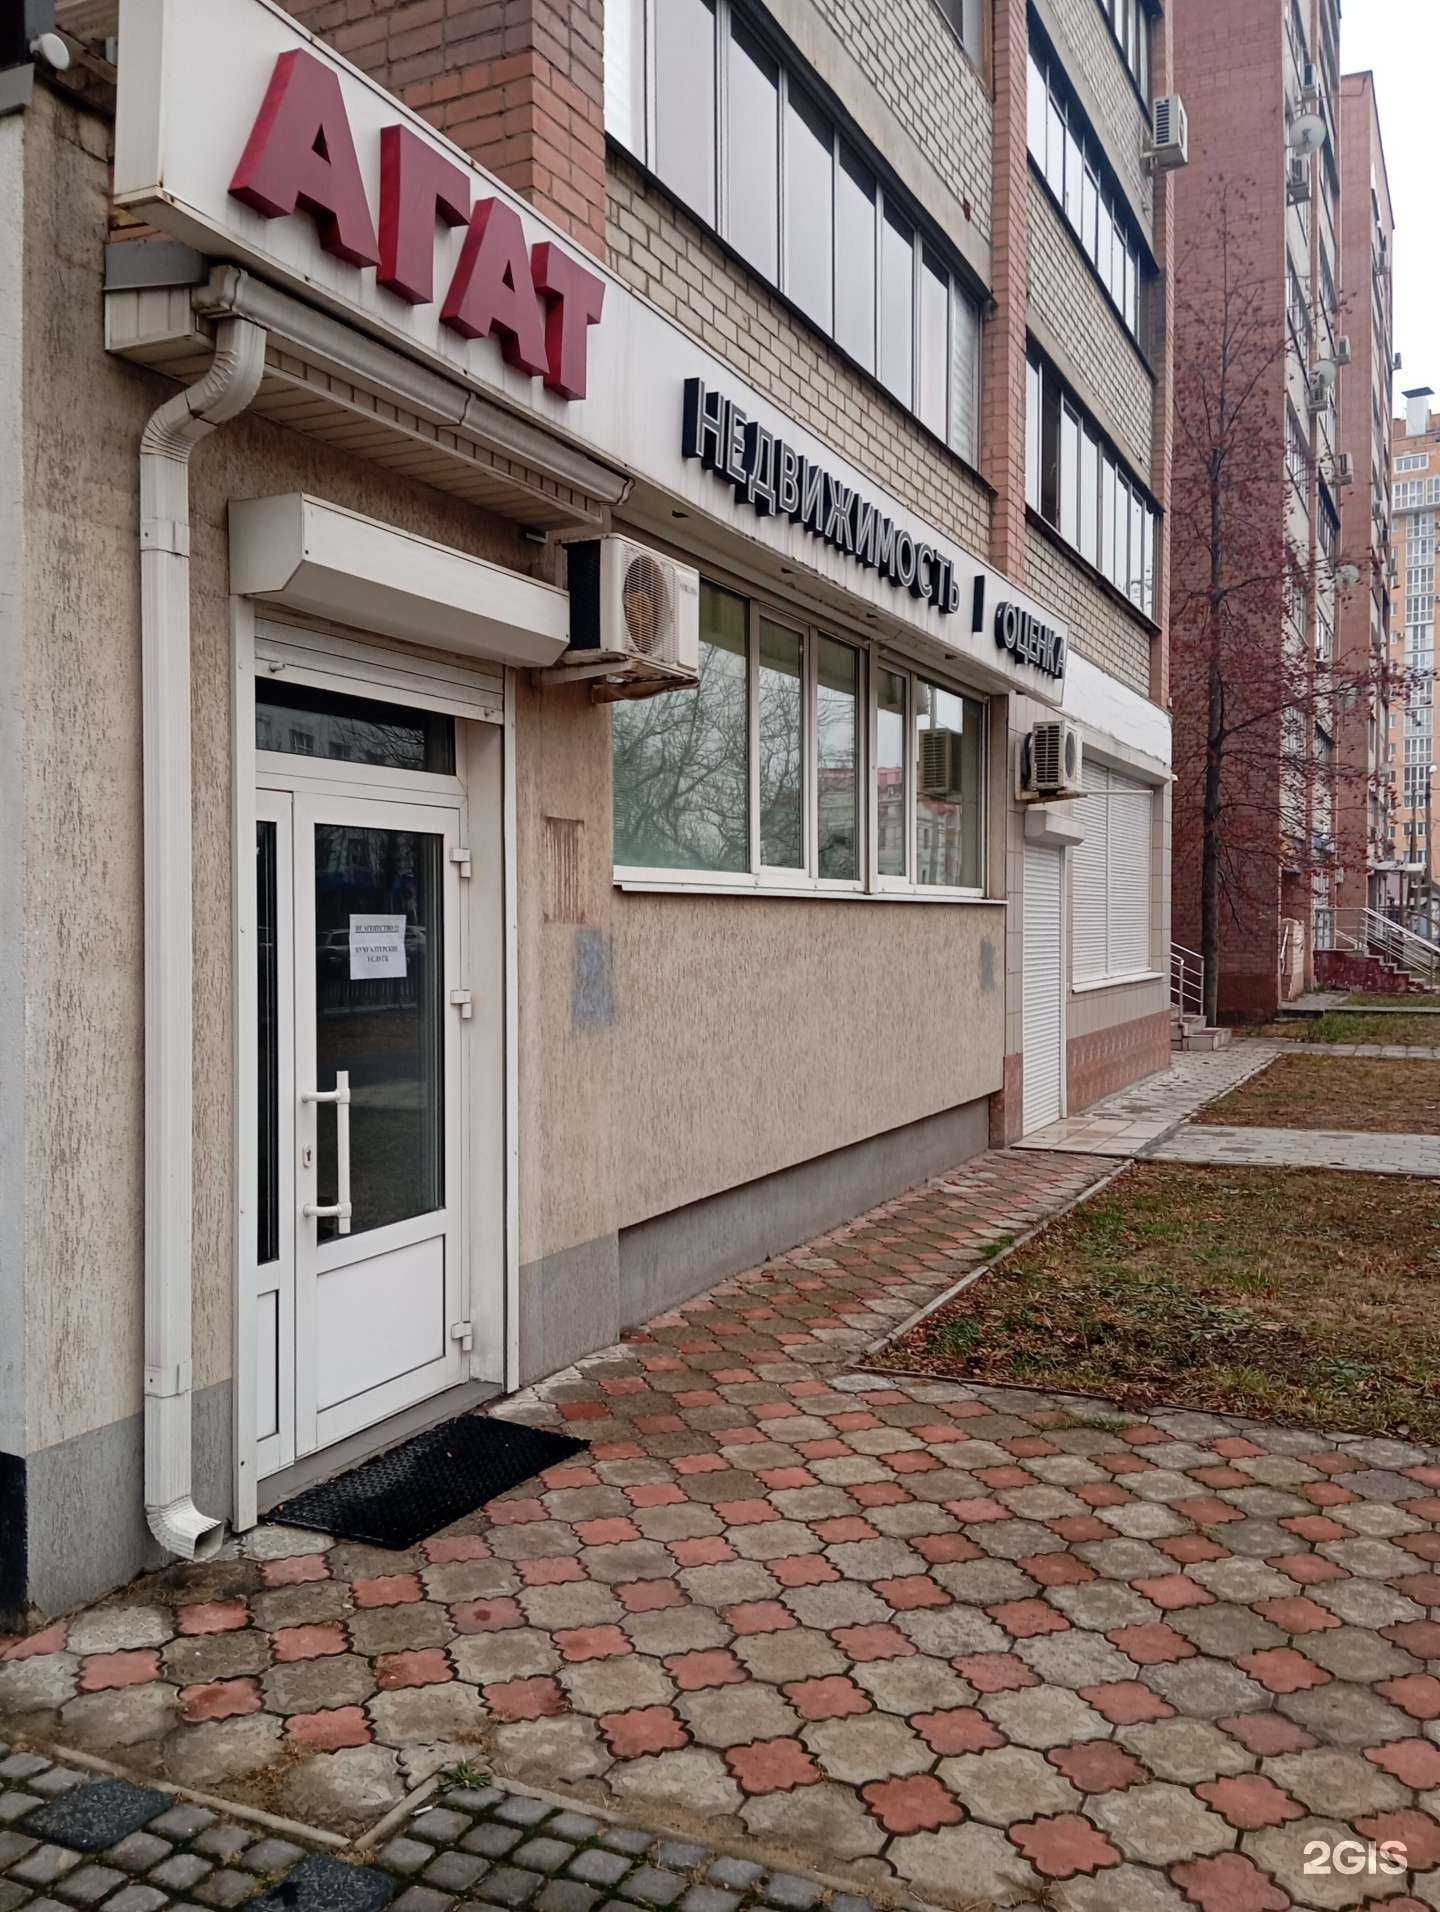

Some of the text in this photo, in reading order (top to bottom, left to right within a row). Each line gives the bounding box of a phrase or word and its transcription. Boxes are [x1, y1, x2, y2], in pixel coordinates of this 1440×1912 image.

[227, 48, 606, 401] АГАТ
[682, 377, 1065, 679] НЕДВИЖИМОСТЬ ОЦЕНКА
